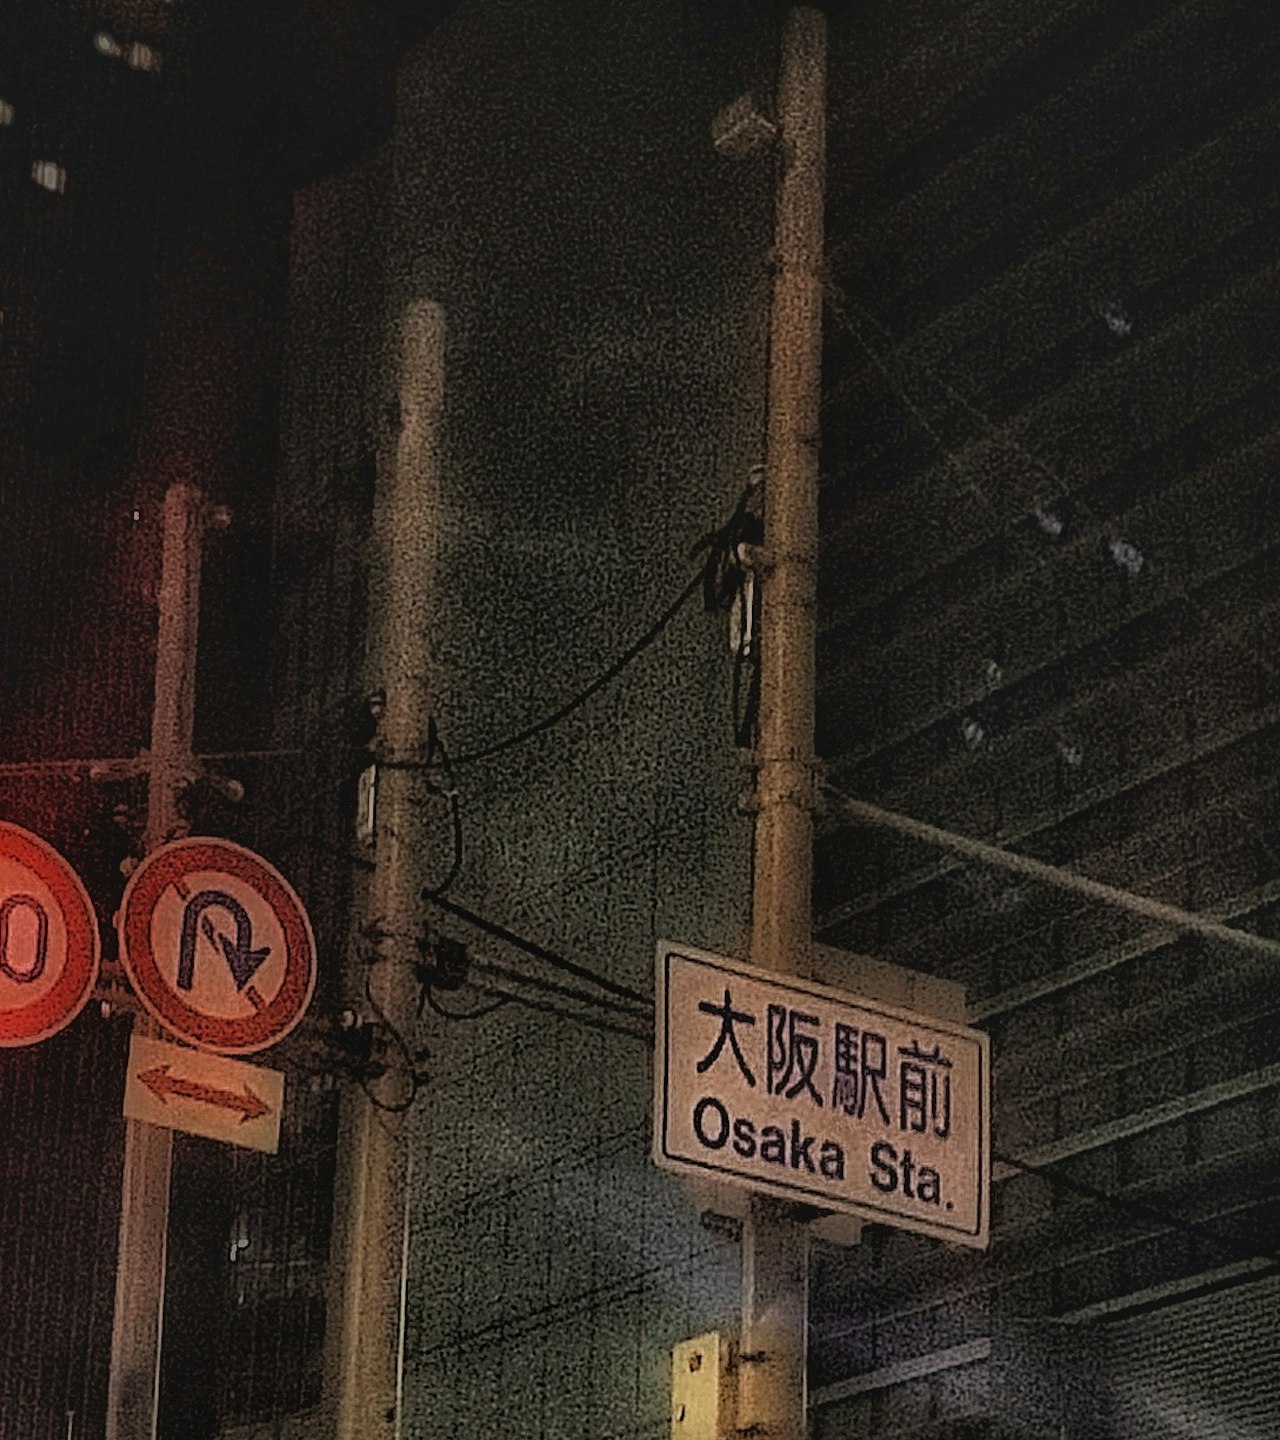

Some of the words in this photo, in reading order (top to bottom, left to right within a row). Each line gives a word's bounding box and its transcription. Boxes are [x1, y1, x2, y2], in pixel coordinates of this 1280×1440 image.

[696, 988, 954, 1139] 大阪駅前
[693, 1096, 845, 1181] Osaka
[870, 1140, 955, 1211] Sta.
